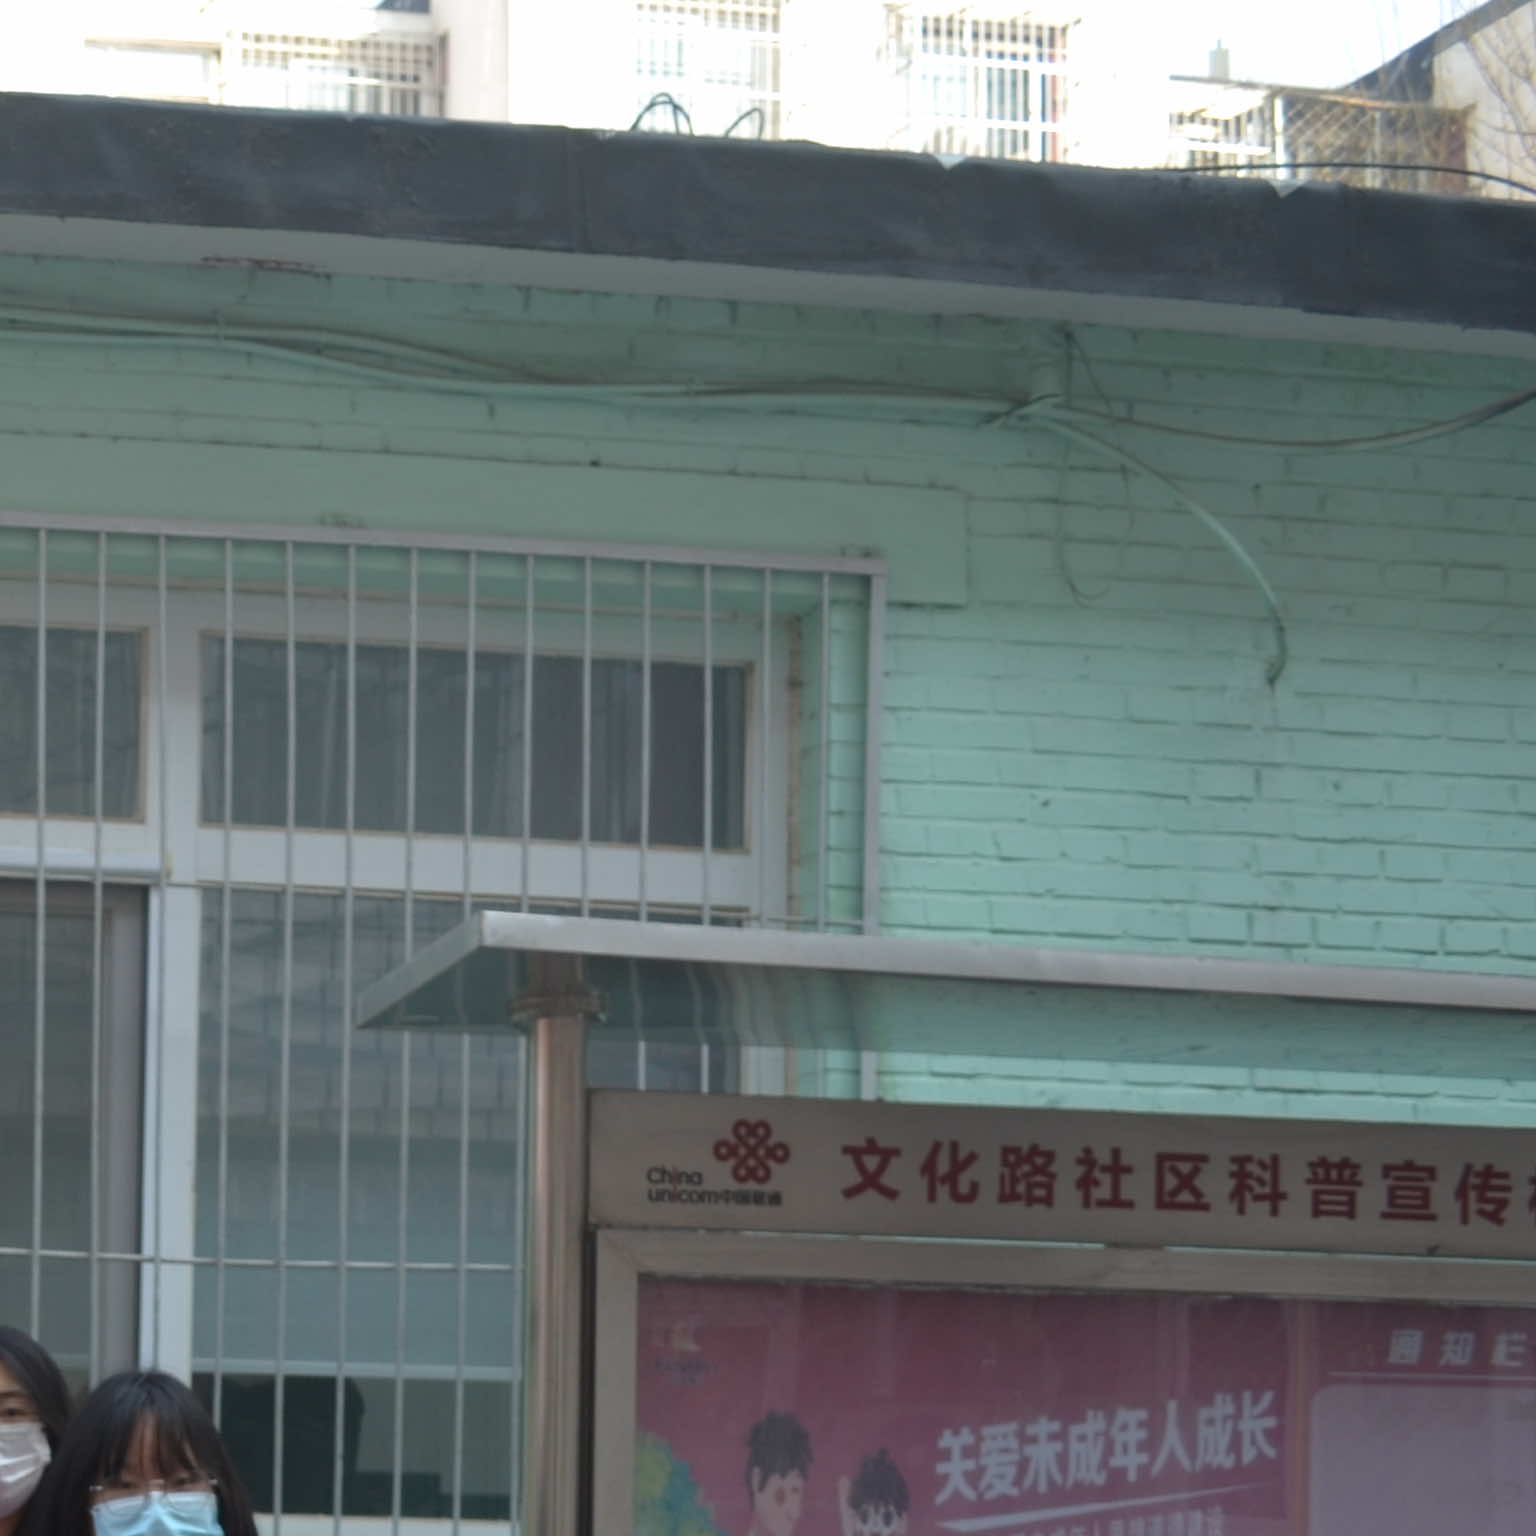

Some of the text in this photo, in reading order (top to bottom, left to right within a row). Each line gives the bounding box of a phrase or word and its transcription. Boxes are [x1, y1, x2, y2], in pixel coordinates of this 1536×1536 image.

[647, 1166, 703, 1186] China
[840, 1137, 1536, 1227] 文化路社区科普宣传
[934, 1390, 1278, 1505] 关爱未成年人成长
